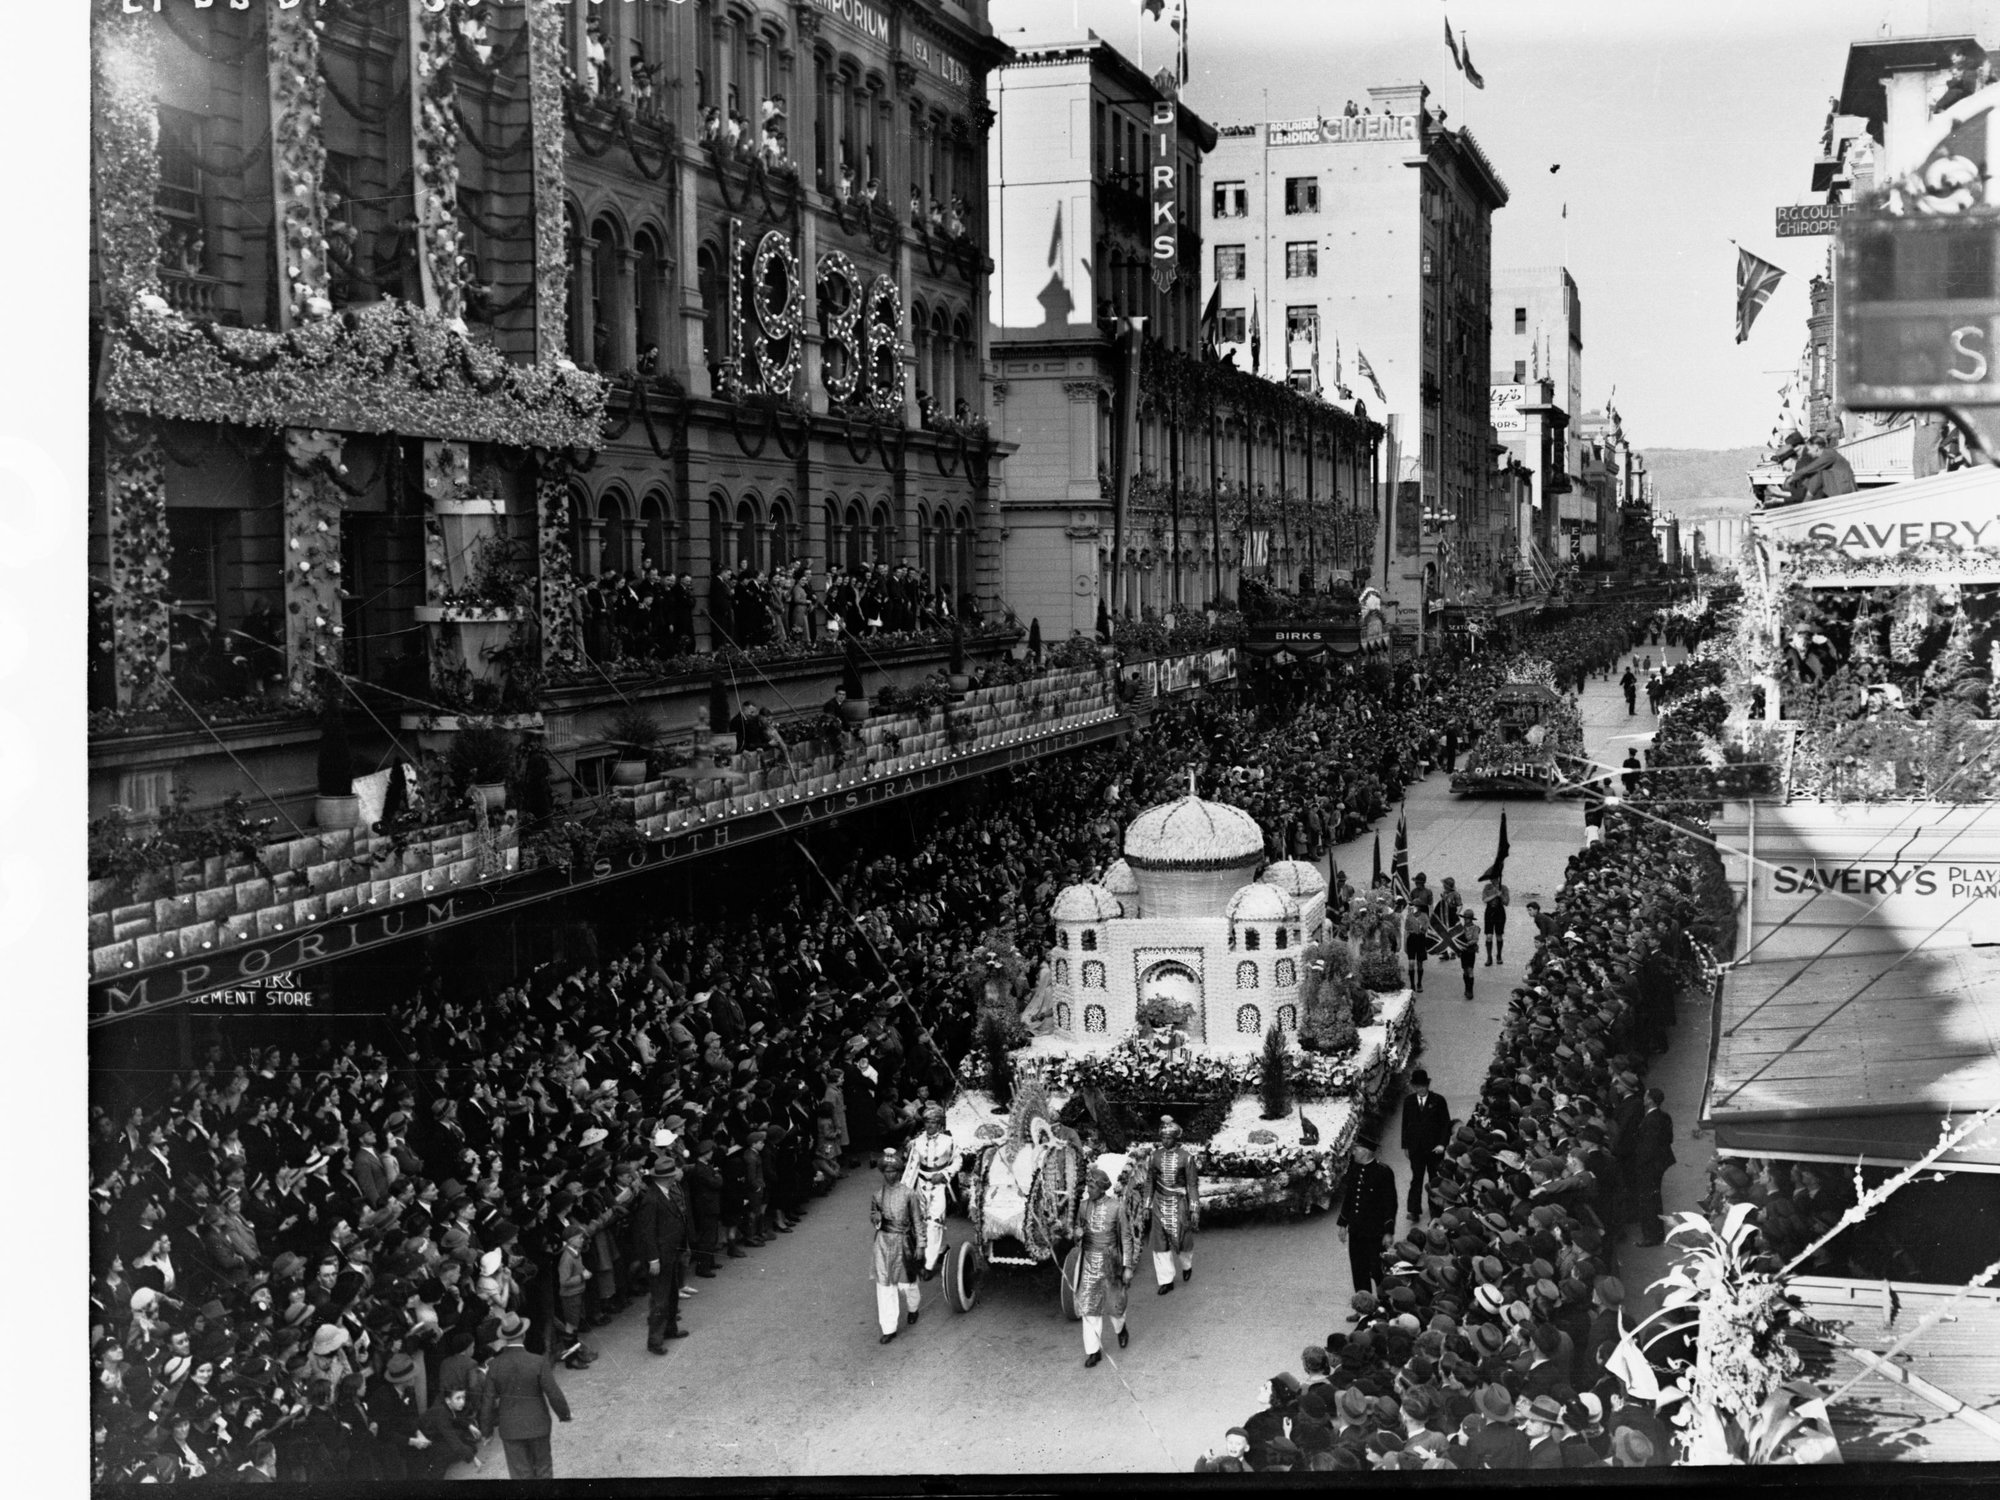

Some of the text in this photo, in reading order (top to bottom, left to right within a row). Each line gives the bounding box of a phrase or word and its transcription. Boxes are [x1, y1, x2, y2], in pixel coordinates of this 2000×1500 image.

[816, 0, 889, 44] PORIUM
[1322, 116, 1417, 142] CINEMA
[1153, 101, 1176, 258] BIRKS
[729, 217, 906, 413] 1936
[1275, 631, 1323, 641] BIRKS
[592, 825, 730, 879] SOUTH
[1773, 864, 1938, 896] SAVERY'S
[1949, 866, 2000, 882] PLAY
[1952, 883, 2000, 899] PIAN
[265, 991, 313, 1006] STORE
